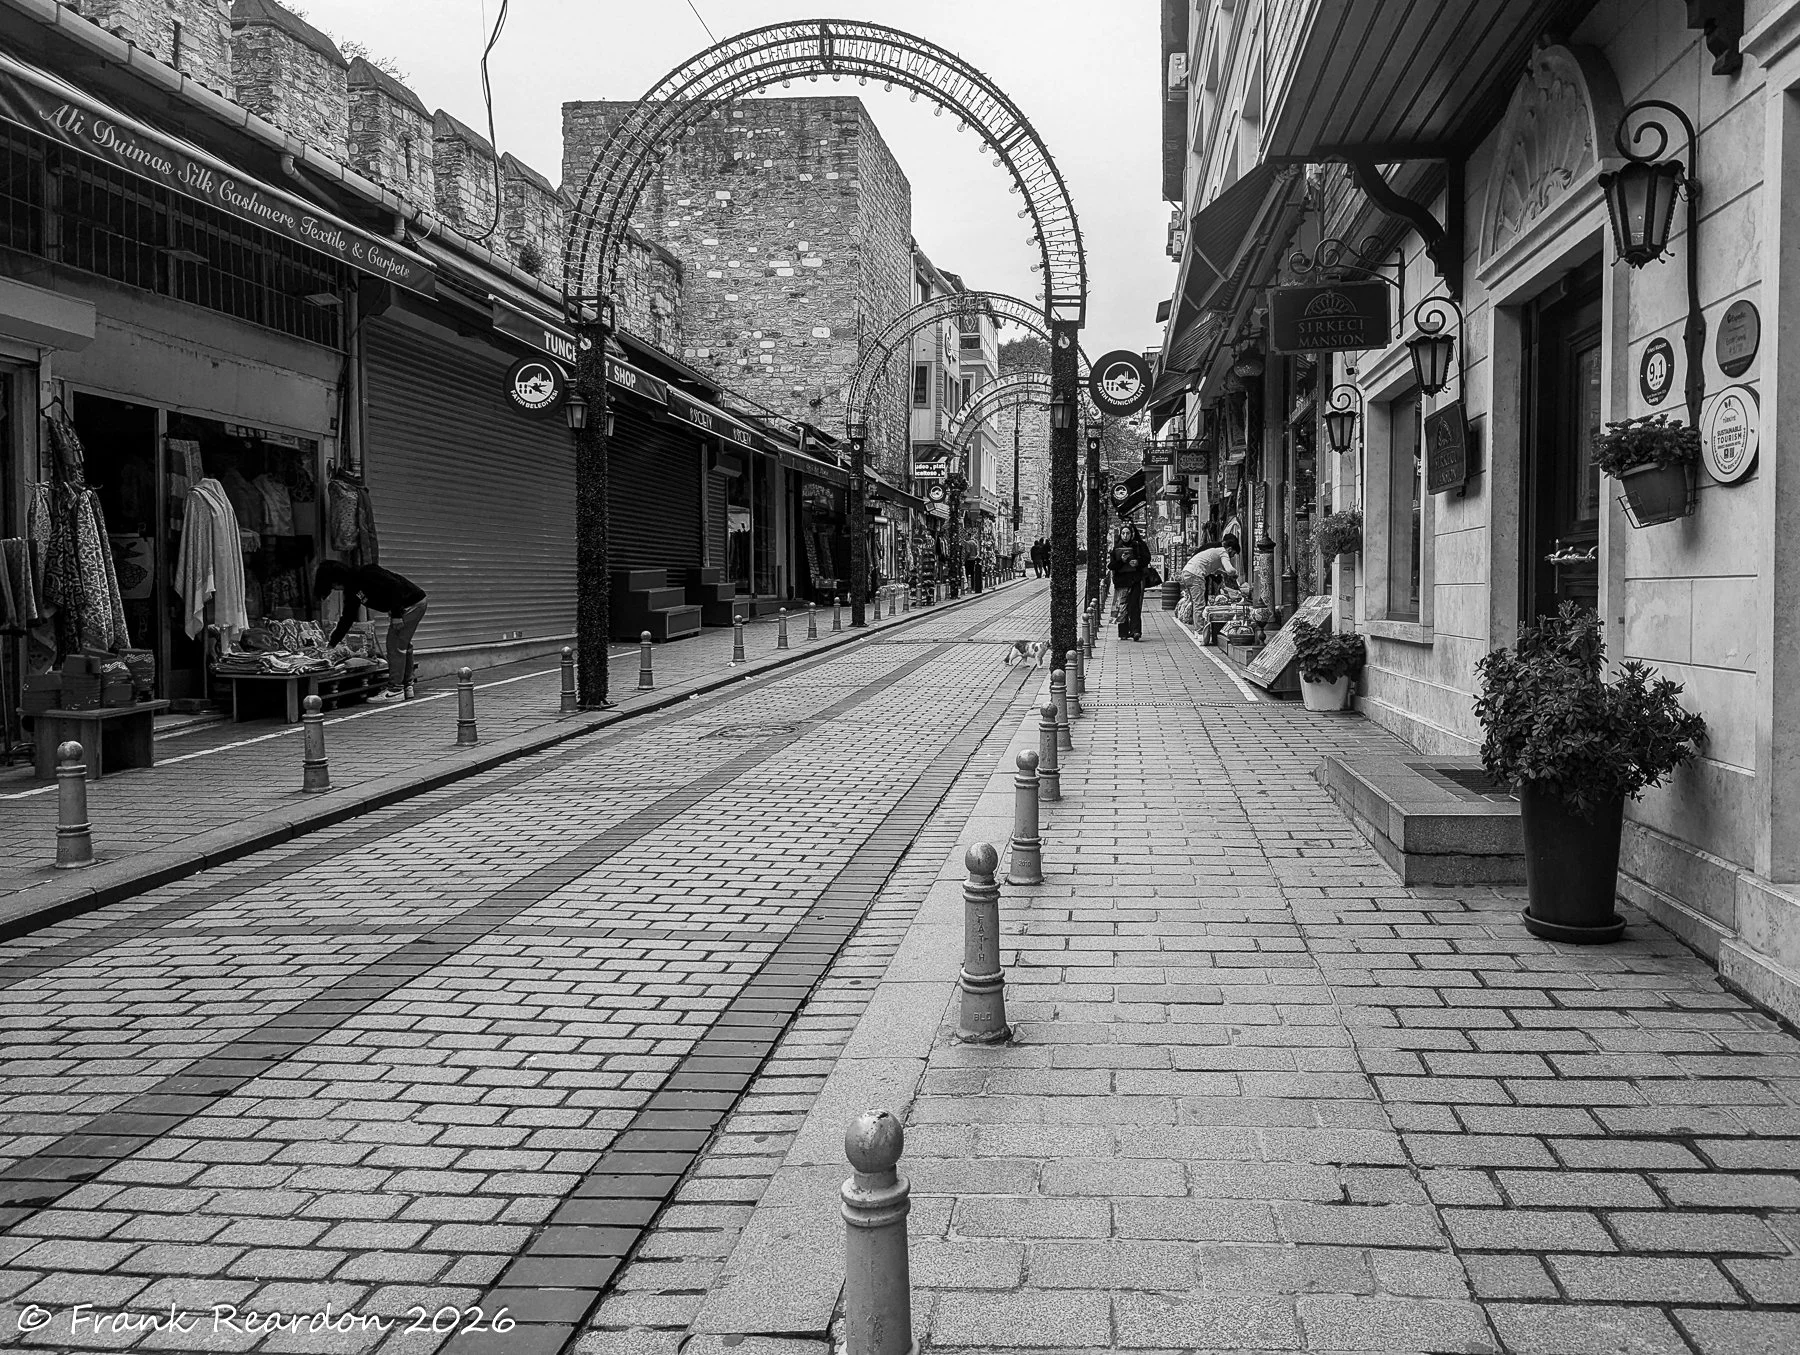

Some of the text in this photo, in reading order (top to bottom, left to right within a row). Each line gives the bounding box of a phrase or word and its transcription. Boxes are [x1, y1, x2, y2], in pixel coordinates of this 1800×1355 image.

[39, 104, 84, 136] Ali
[177, 162, 215, 194] Silk
[219, 180, 296, 229] Cashmere
[300, 215, 348, 251] Textile
[351, 243, 364, 258] &
[367, 247, 411, 279] Carpets
[1298, 319, 1364, 334] SIRKECI
[1298, 333, 1365, 348] MANSION
[544, 330, 577, 362] TUNCE
[614, 365, 636, 388] SHOP
[1649, 359, 1664, 382] 9.1
[1107, 383, 1146, 406] MUNICIPALITY
[1717, 424, 1742, 437] SUSTAINABLE
[1717, 432, 1742, 445] TOURISM
